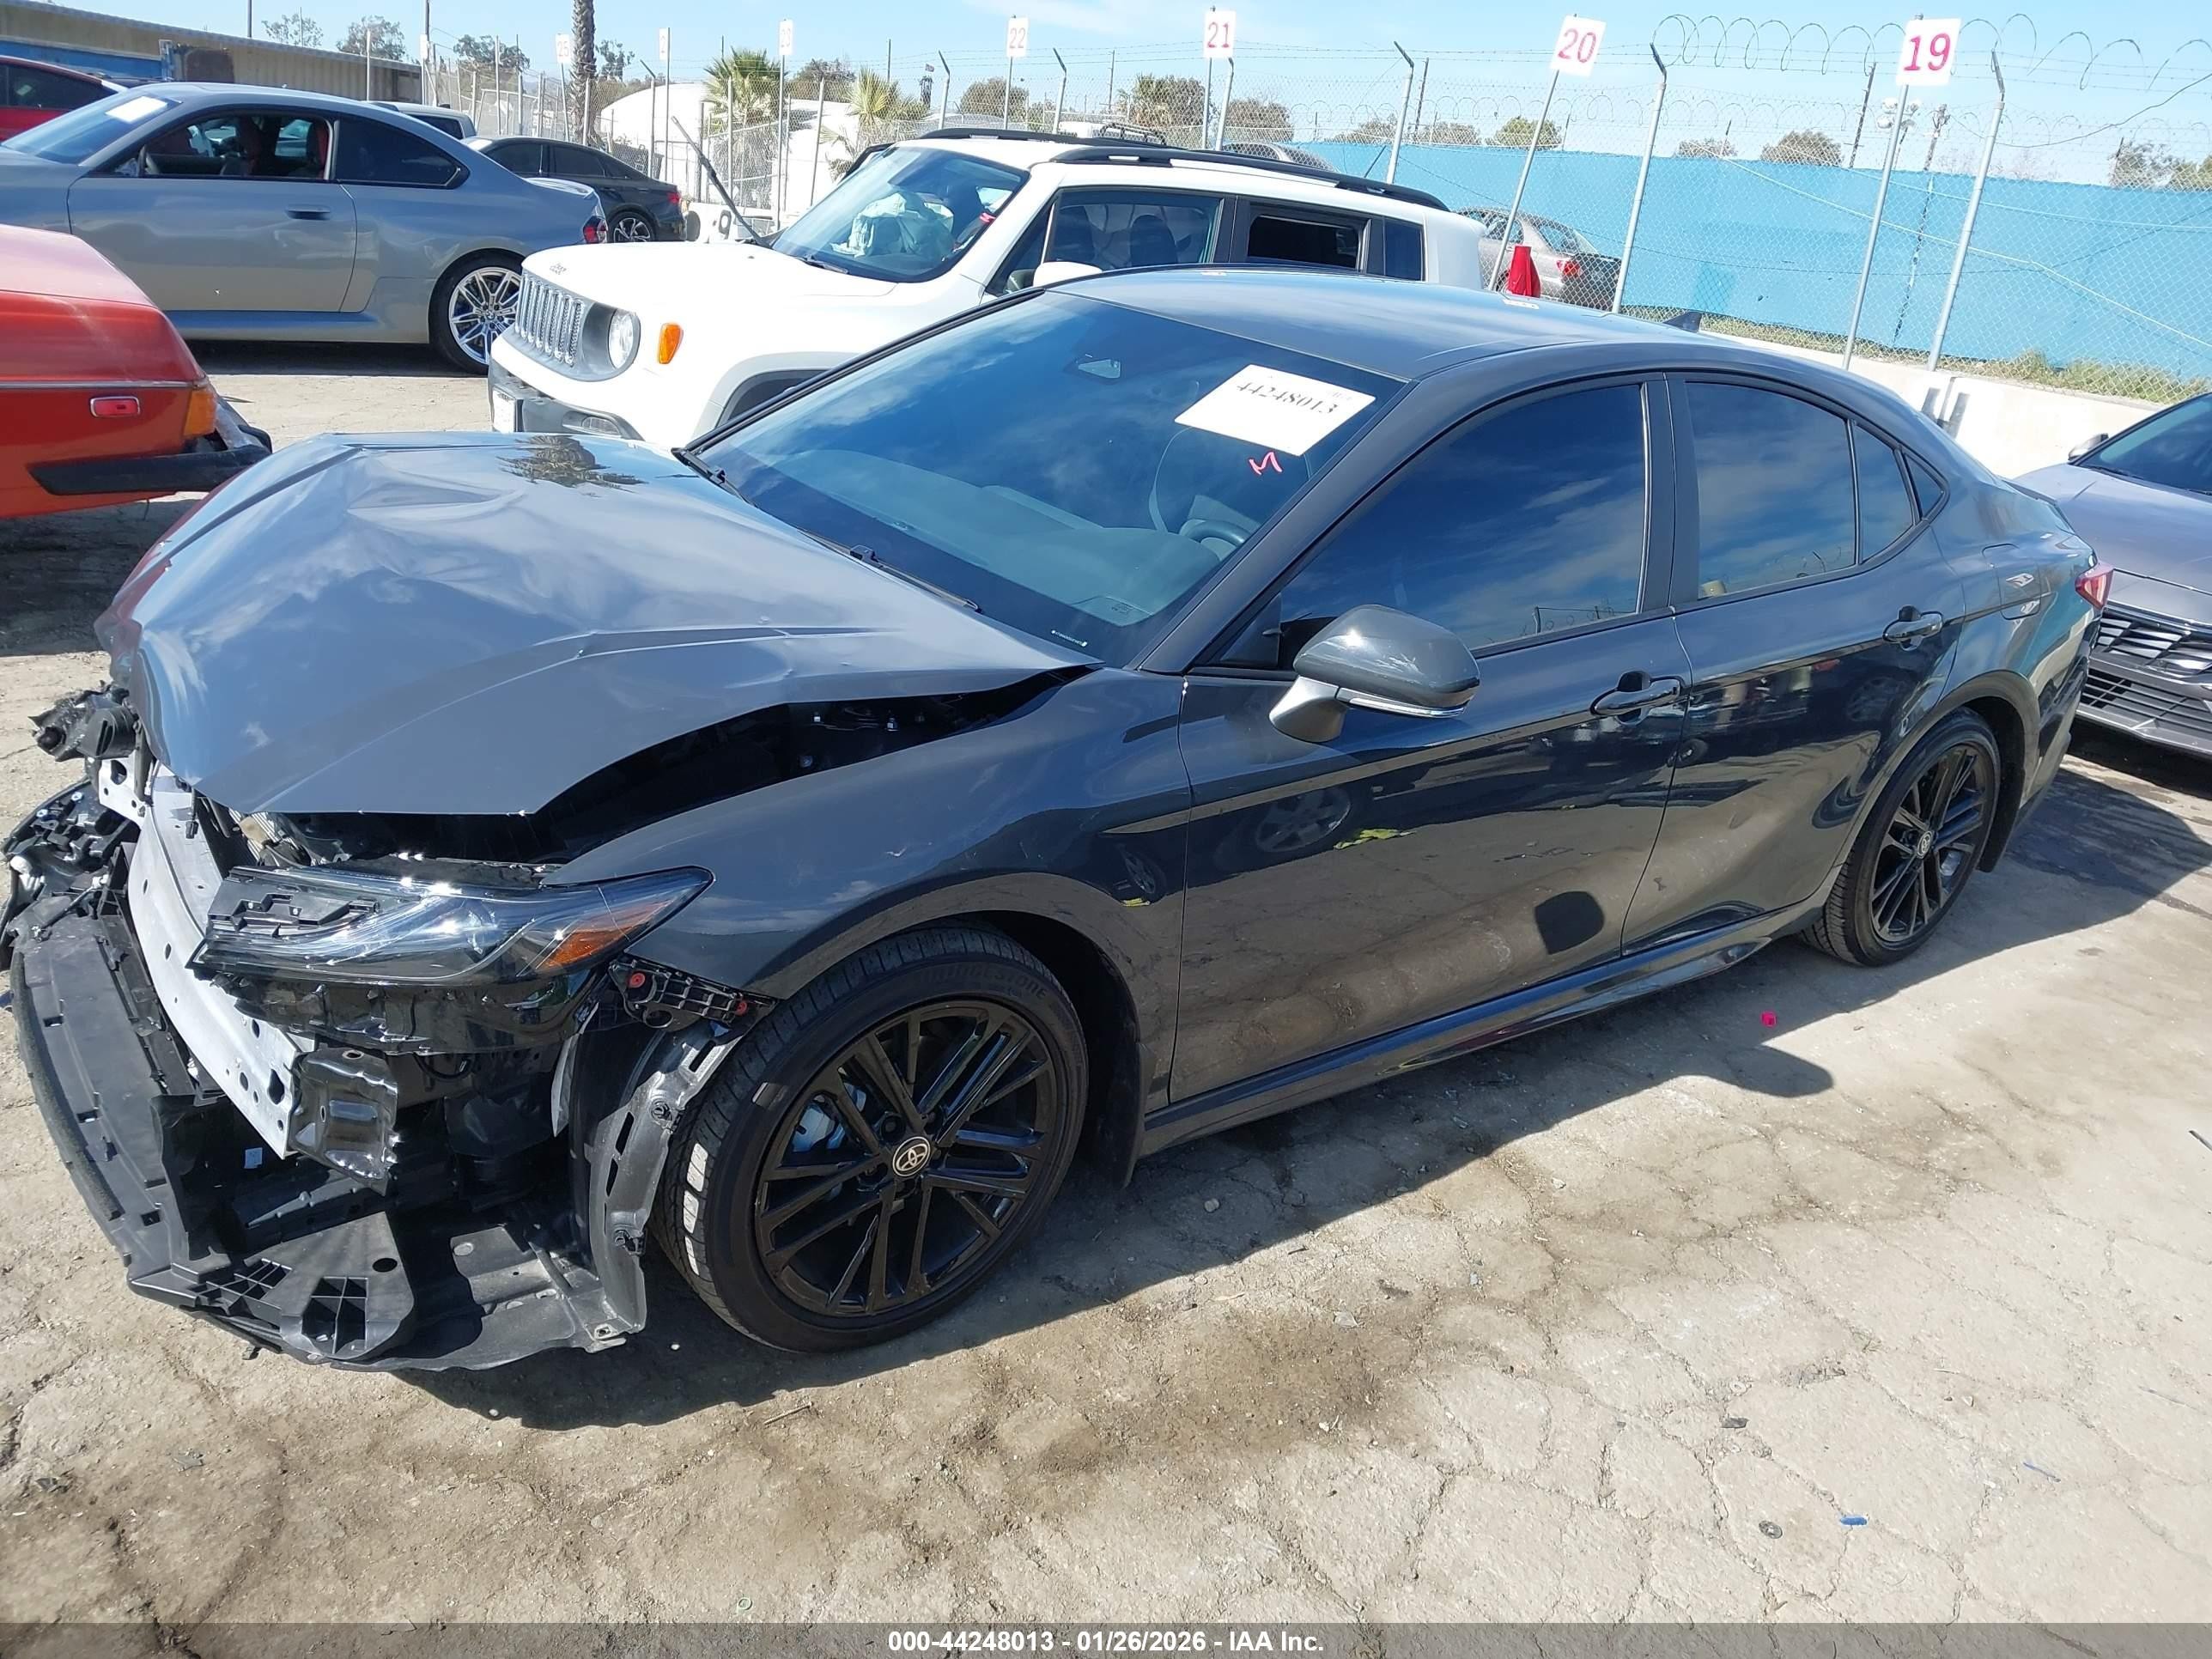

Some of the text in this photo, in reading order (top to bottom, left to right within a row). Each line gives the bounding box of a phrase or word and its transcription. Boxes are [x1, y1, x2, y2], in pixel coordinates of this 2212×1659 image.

[1009, 27, 1026, 49] 22
[1207, 21, 1231, 48] 21
[1558, 28, 1596, 64] 20
[1903, 33, 1951, 70] 19
[1237, 383, 1337, 413] 44248013
